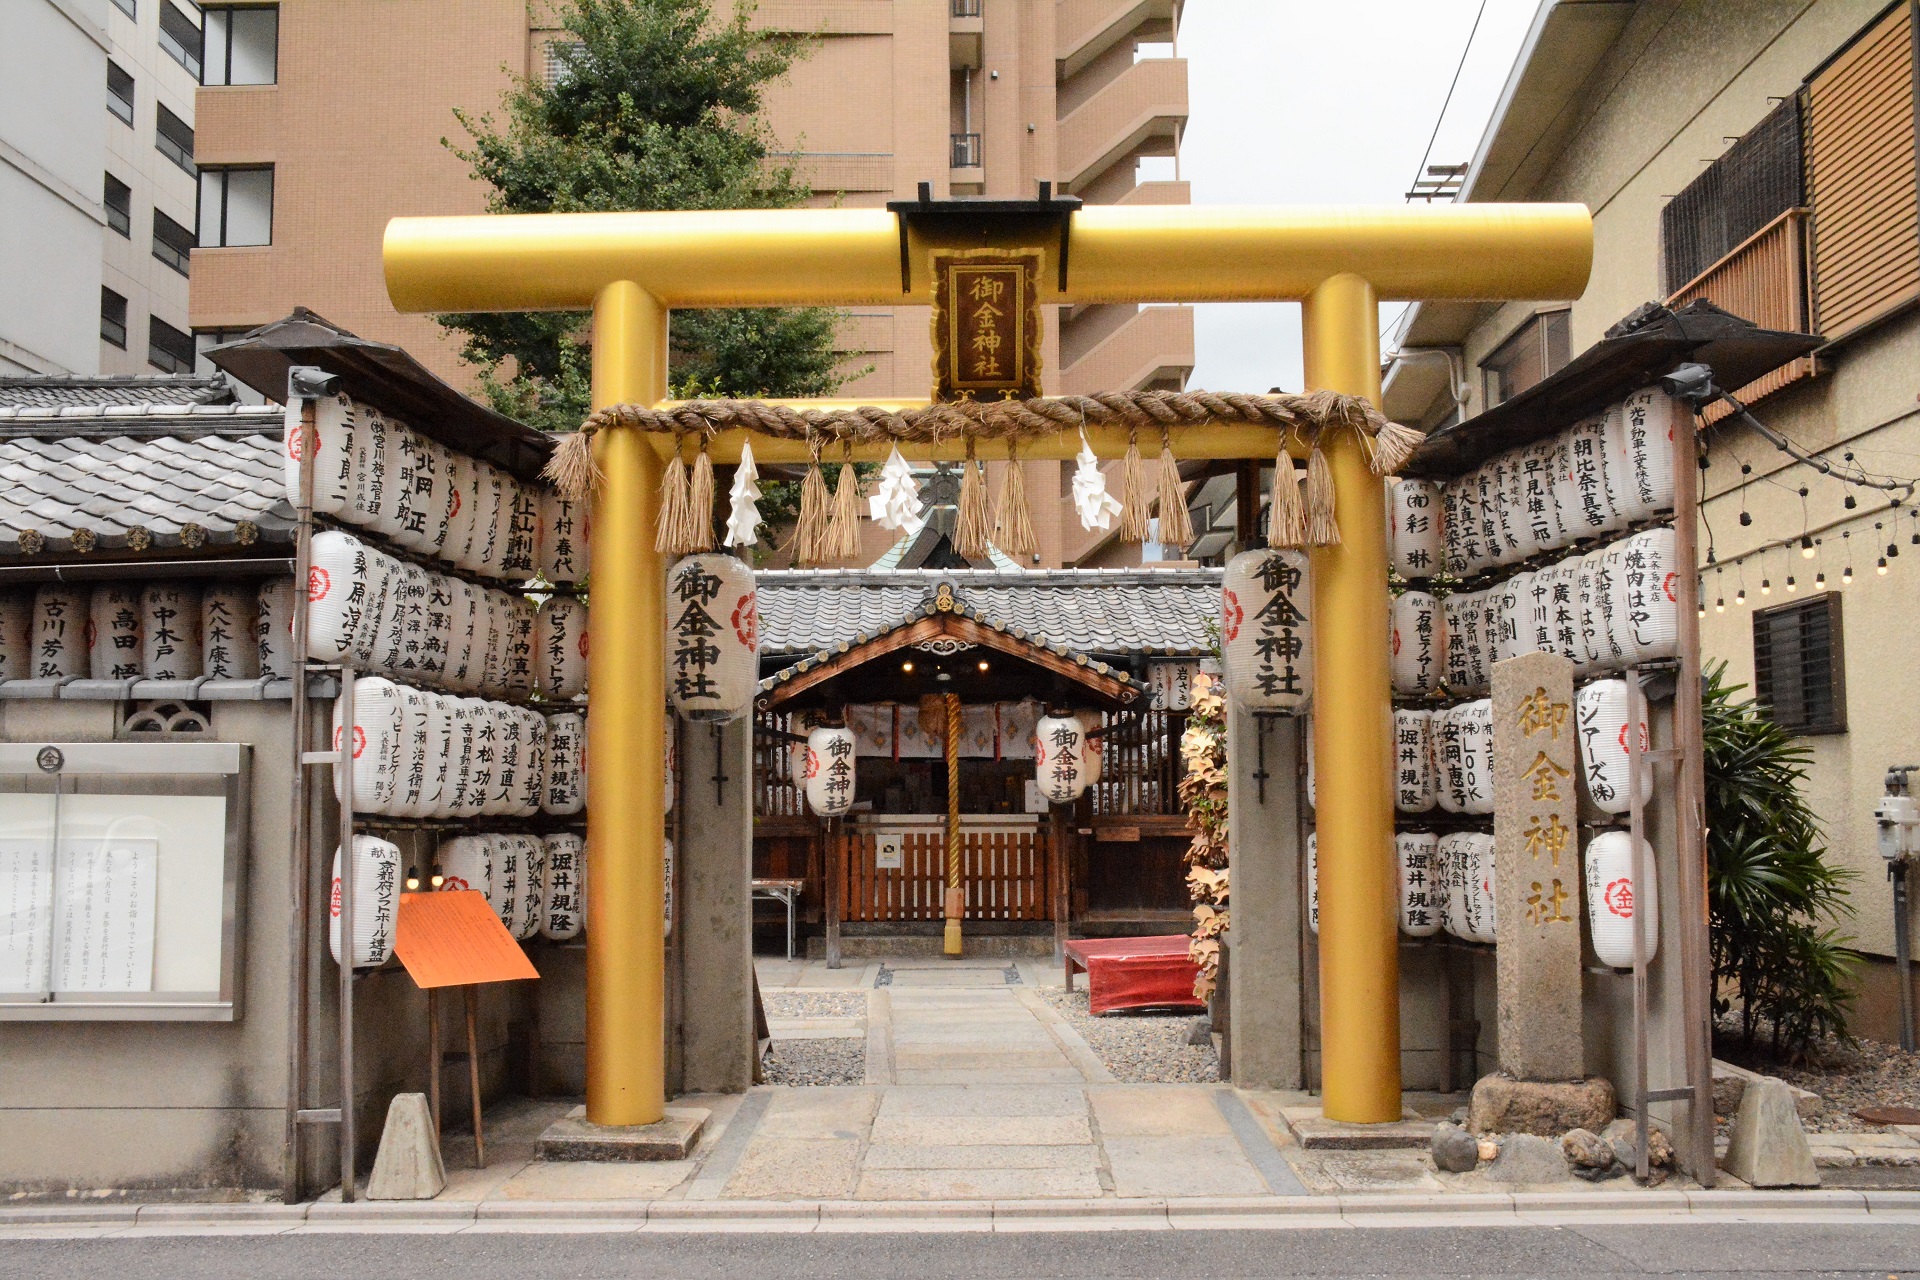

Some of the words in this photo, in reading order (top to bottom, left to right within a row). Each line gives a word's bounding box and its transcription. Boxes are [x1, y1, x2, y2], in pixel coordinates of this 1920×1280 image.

[969, 275, 1004, 376] 御金神社
[405, 453, 435, 535] 北岡正
[1523, 459, 1551, 543] 早見雄二郎
[1573, 438, 1606, 527] 朝比奈真吾
[553, 500, 574, 574] 下村春代
[39, 599, 68, 678] 古川芳弘
[208, 600, 234, 679] 大八木康夫
[335, 551, 368, 652] 桑原淳子
[672, 561, 724, 700] 御金神社
[1251, 554, 1308, 697] 御金神社
[548, 613, 568, 694] ビッグネットアイ
[549, 734, 571, 805] 堀井規隆
[824, 734, 852, 811] 御金神社
[1050, 724, 1079, 800] 御金神社
[1399, 729, 1421, 805] 堀井規隆
[1517, 686, 1572, 926] 御金神社
[365, 861, 396, 962] 京都府ソフトボール連盟
[550, 853, 574, 931] 堀井規隆
[1406, 854, 1432, 926] 堀井規隆
